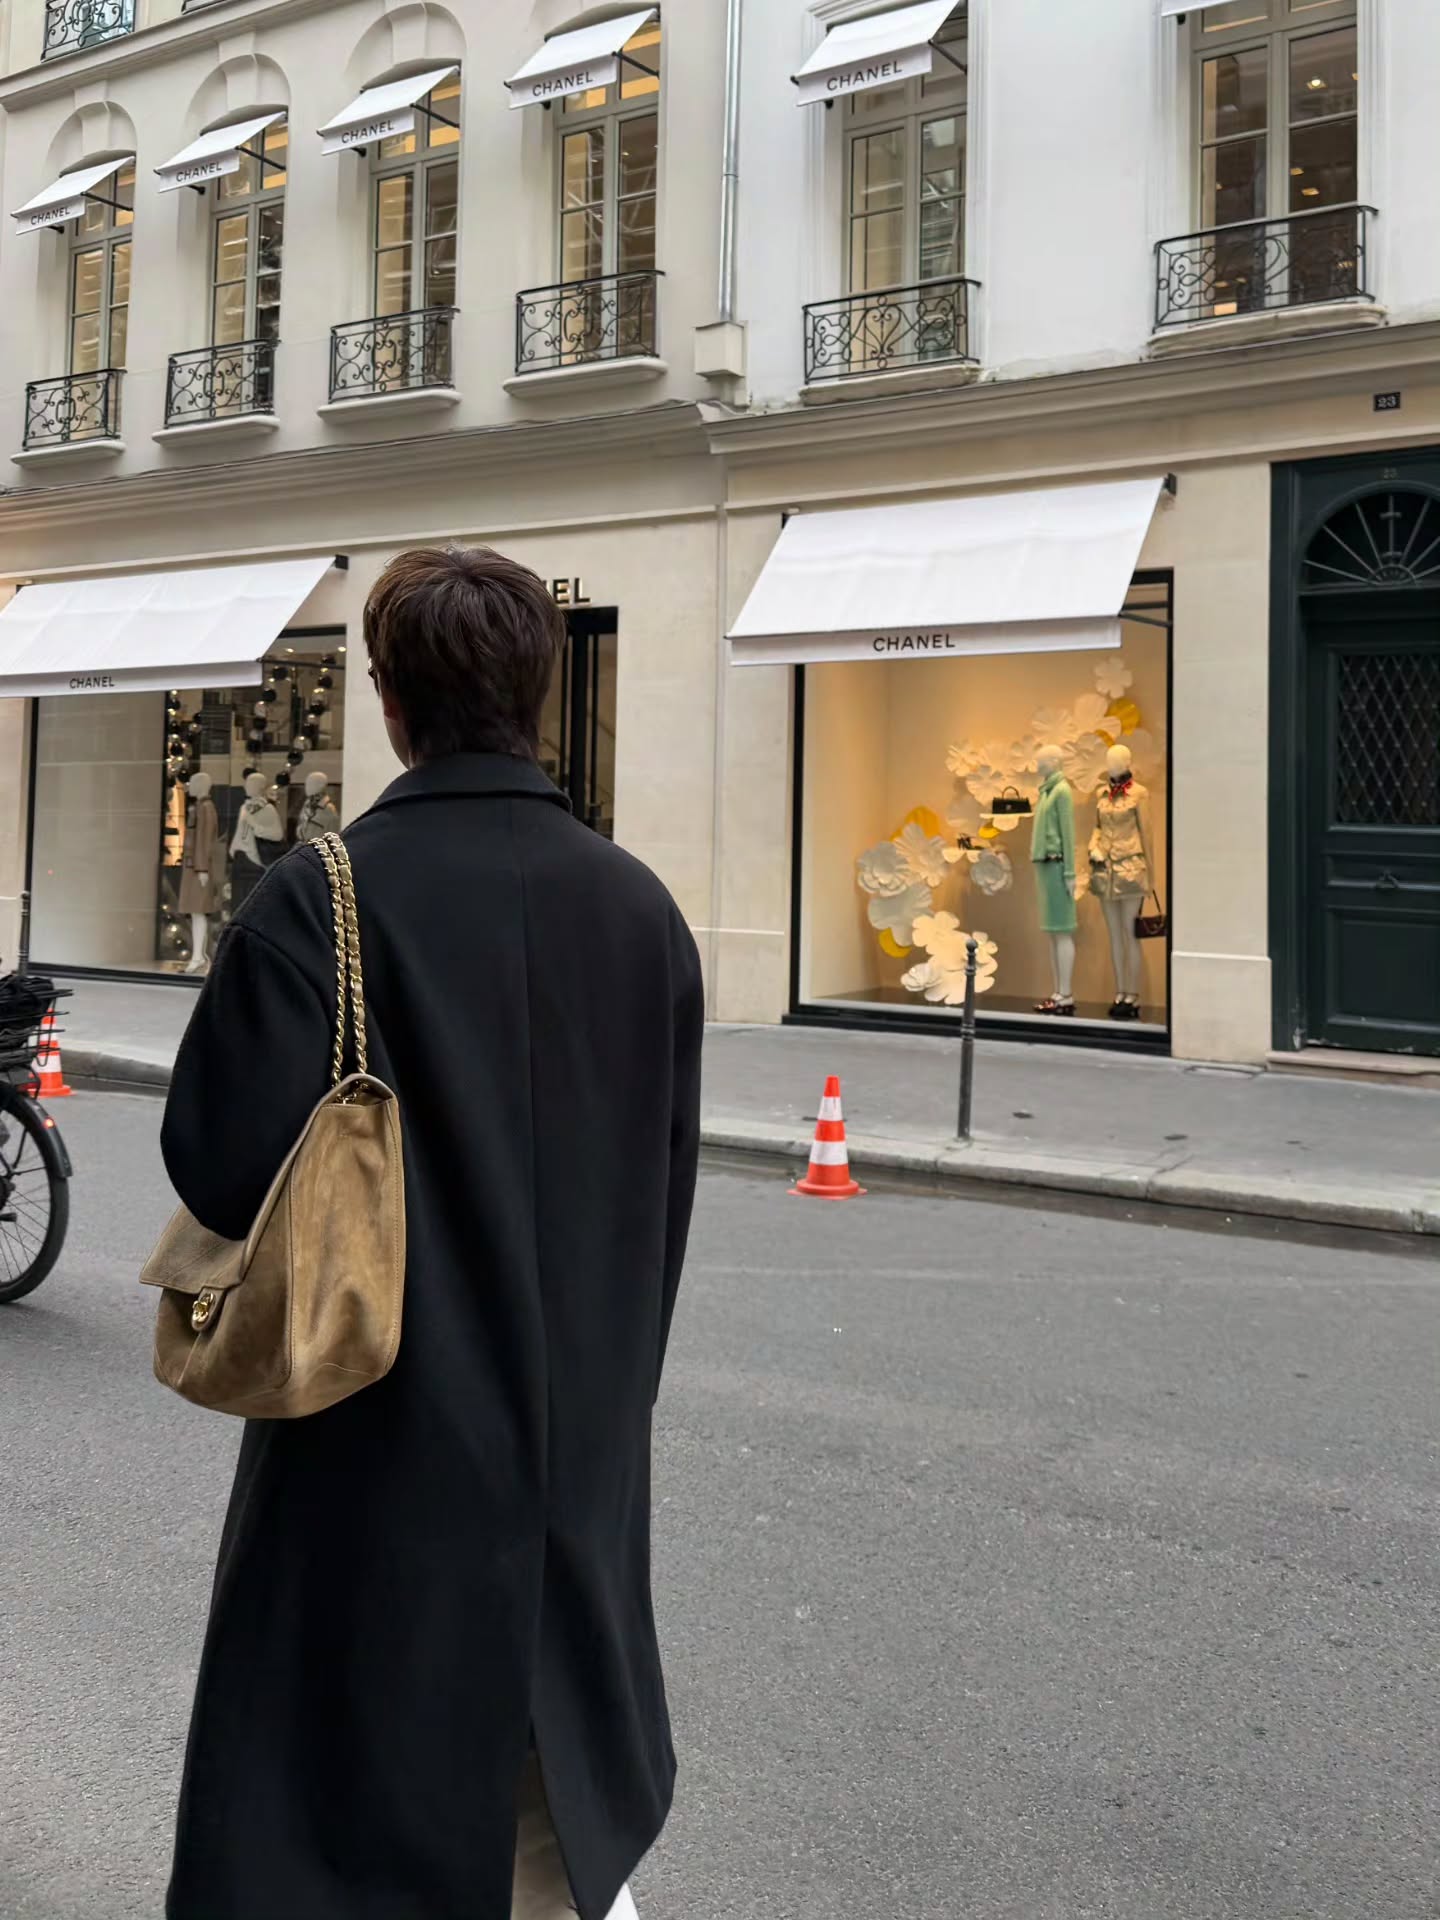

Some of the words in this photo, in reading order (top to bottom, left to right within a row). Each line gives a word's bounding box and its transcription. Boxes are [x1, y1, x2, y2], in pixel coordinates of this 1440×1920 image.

[532, 71, 593, 96] CHANEL
[826, 61, 902, 91] CHANEL
[341, 119, 394, 143] CHANEL
[176, 161, 222, 182] CHANEL
[30, 207, 71, 225] CHANEL
[1377, 395, 1397, 408] 23
[541, 577, 591, 604] EL
[873, 633, 956, 652] CHANEL
[69, 676, 115, 689] CHANEL
